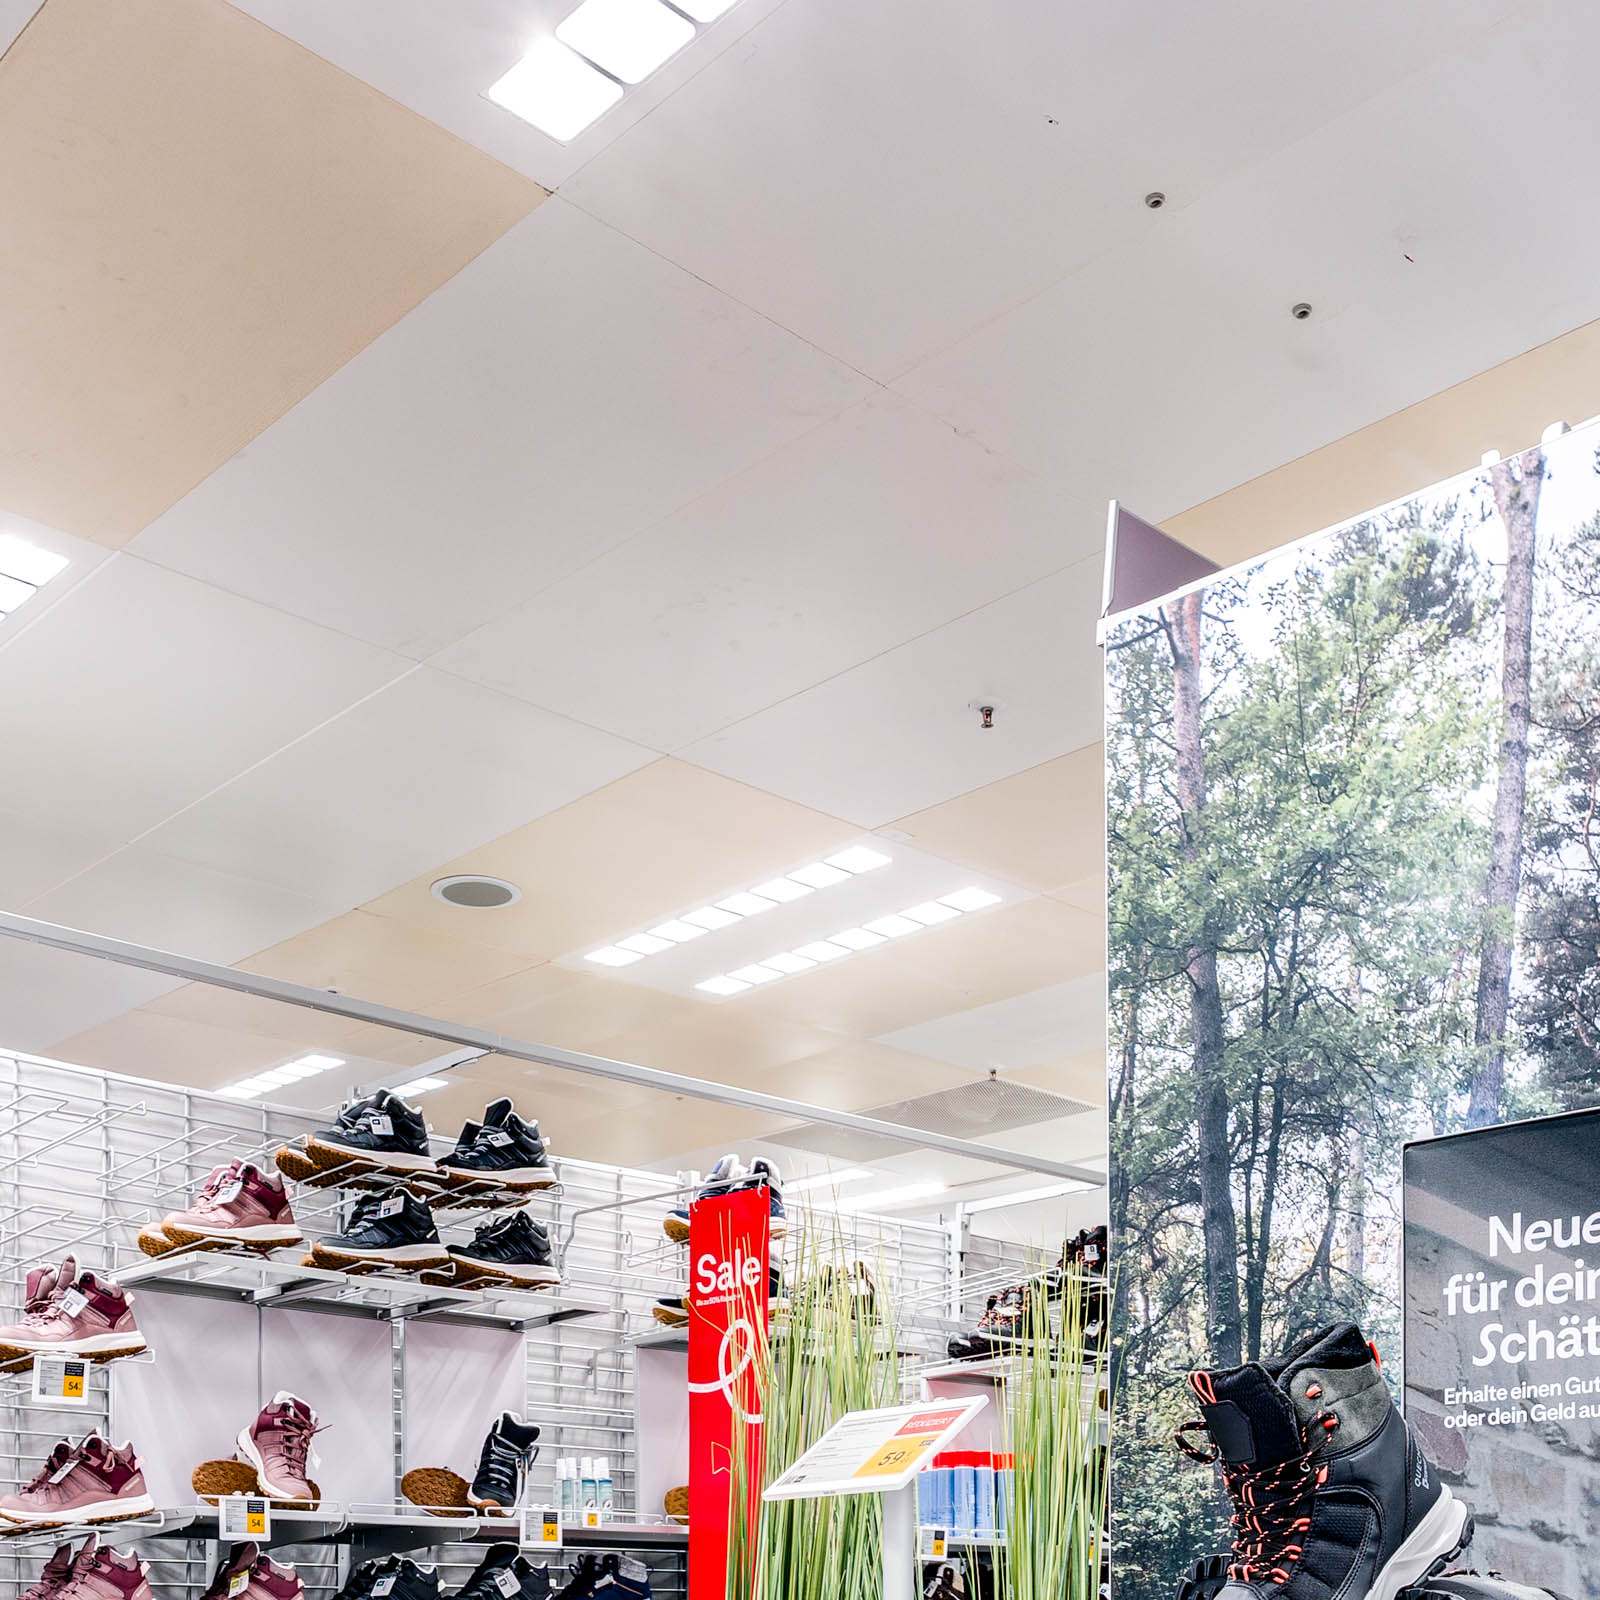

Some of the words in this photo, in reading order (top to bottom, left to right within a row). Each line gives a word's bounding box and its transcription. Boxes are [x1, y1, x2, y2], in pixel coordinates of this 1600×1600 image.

[695, 1247, 761, 1295] Sale
[1442, 1271, 1508, 1317] für
[1443, 1384, 1509, 1406] Erhalte
[1510, 1380, 1562, 1400] einen
[1443, 1410, 1487, 1429] oder
[1487, 1406, 1528, 1425] dein
[1530, 1402, 1576, 1423] Geld
[877, 1450, 903, 1467] 59
